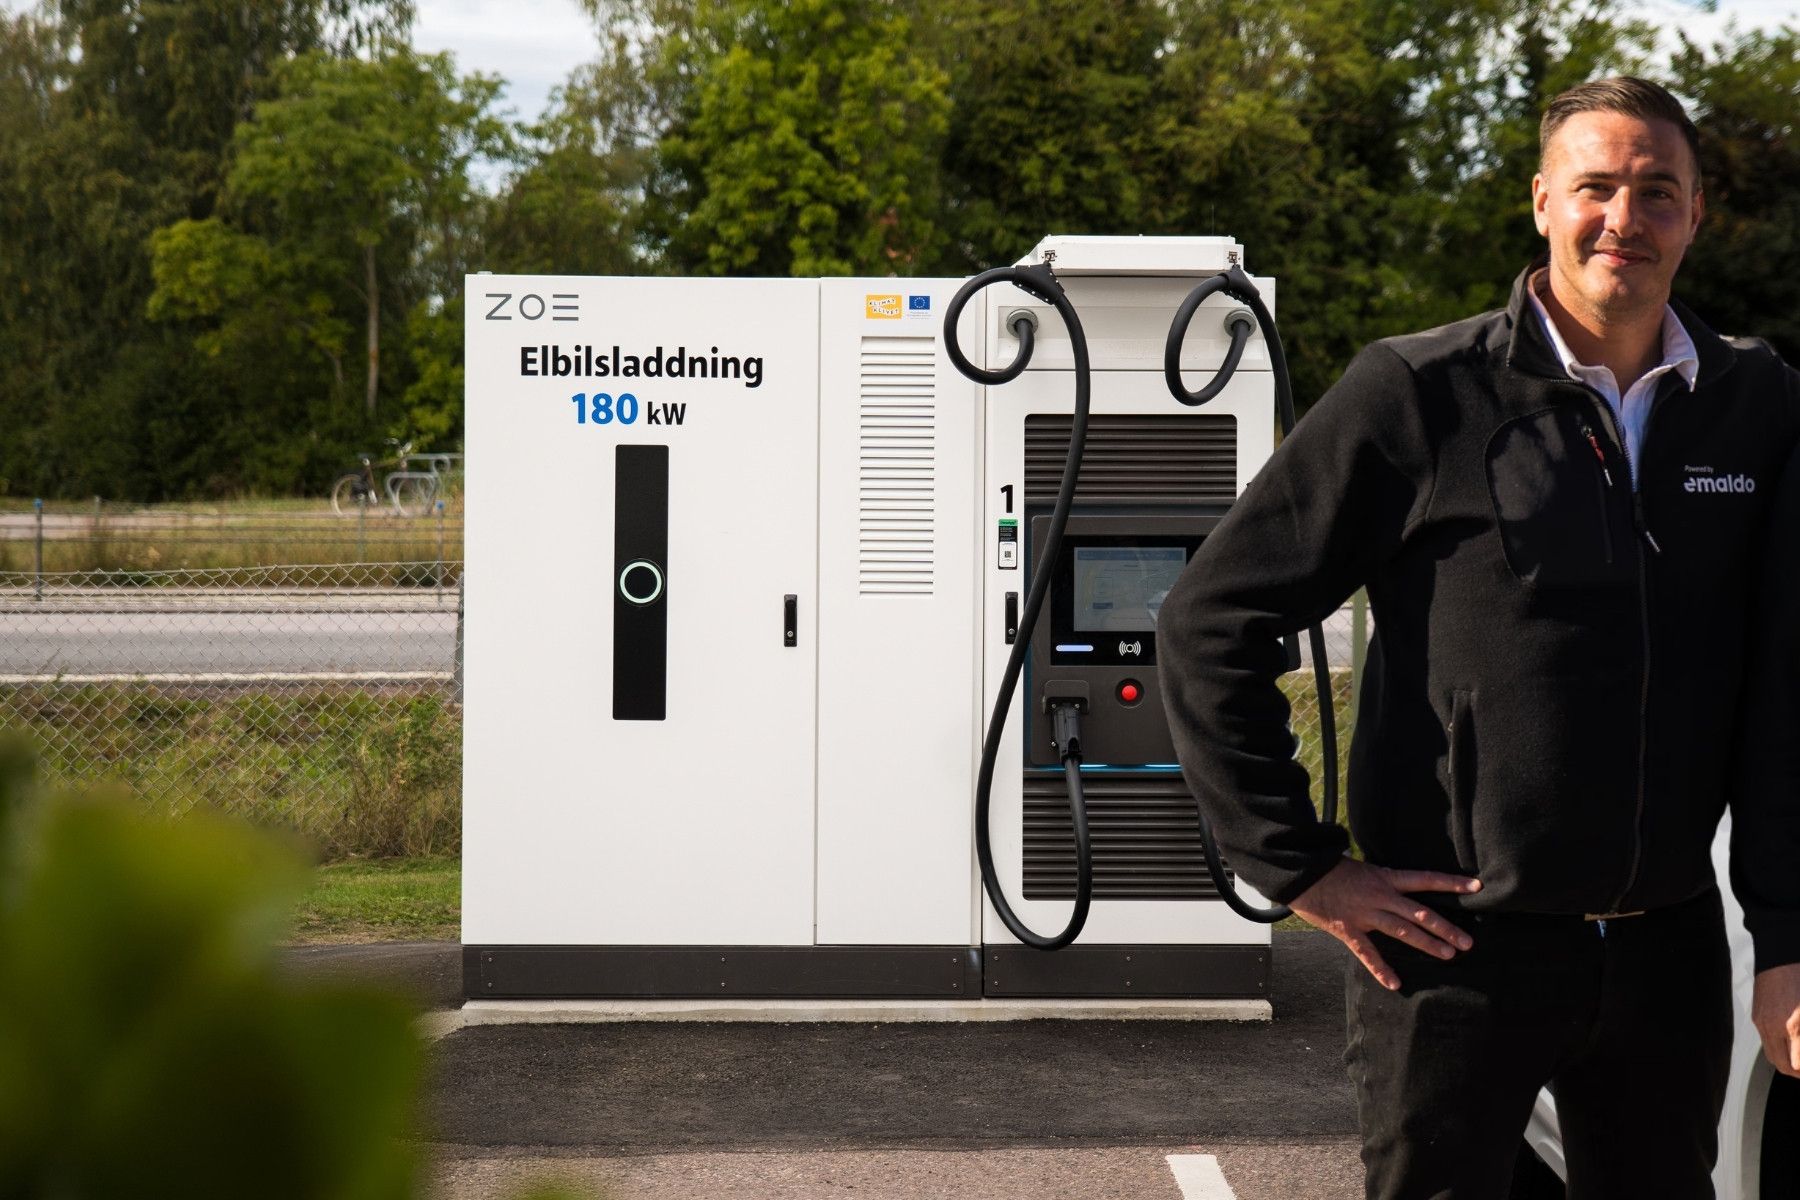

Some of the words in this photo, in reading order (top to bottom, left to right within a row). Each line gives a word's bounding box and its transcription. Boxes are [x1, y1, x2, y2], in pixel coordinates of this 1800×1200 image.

[485, 293, 580, 322] ZOE
[520, 345, 764, 388] Elbilsladdning
[571, 393, 639, 425] 180
[647, 401, 687, 425] kW
[1683, 474, 1756, 493] emaldo
[1684, 465, 1707, 473] Powered
[1707, 466, 1714, 474] by
[1000, 484, 1014, 514] 1
